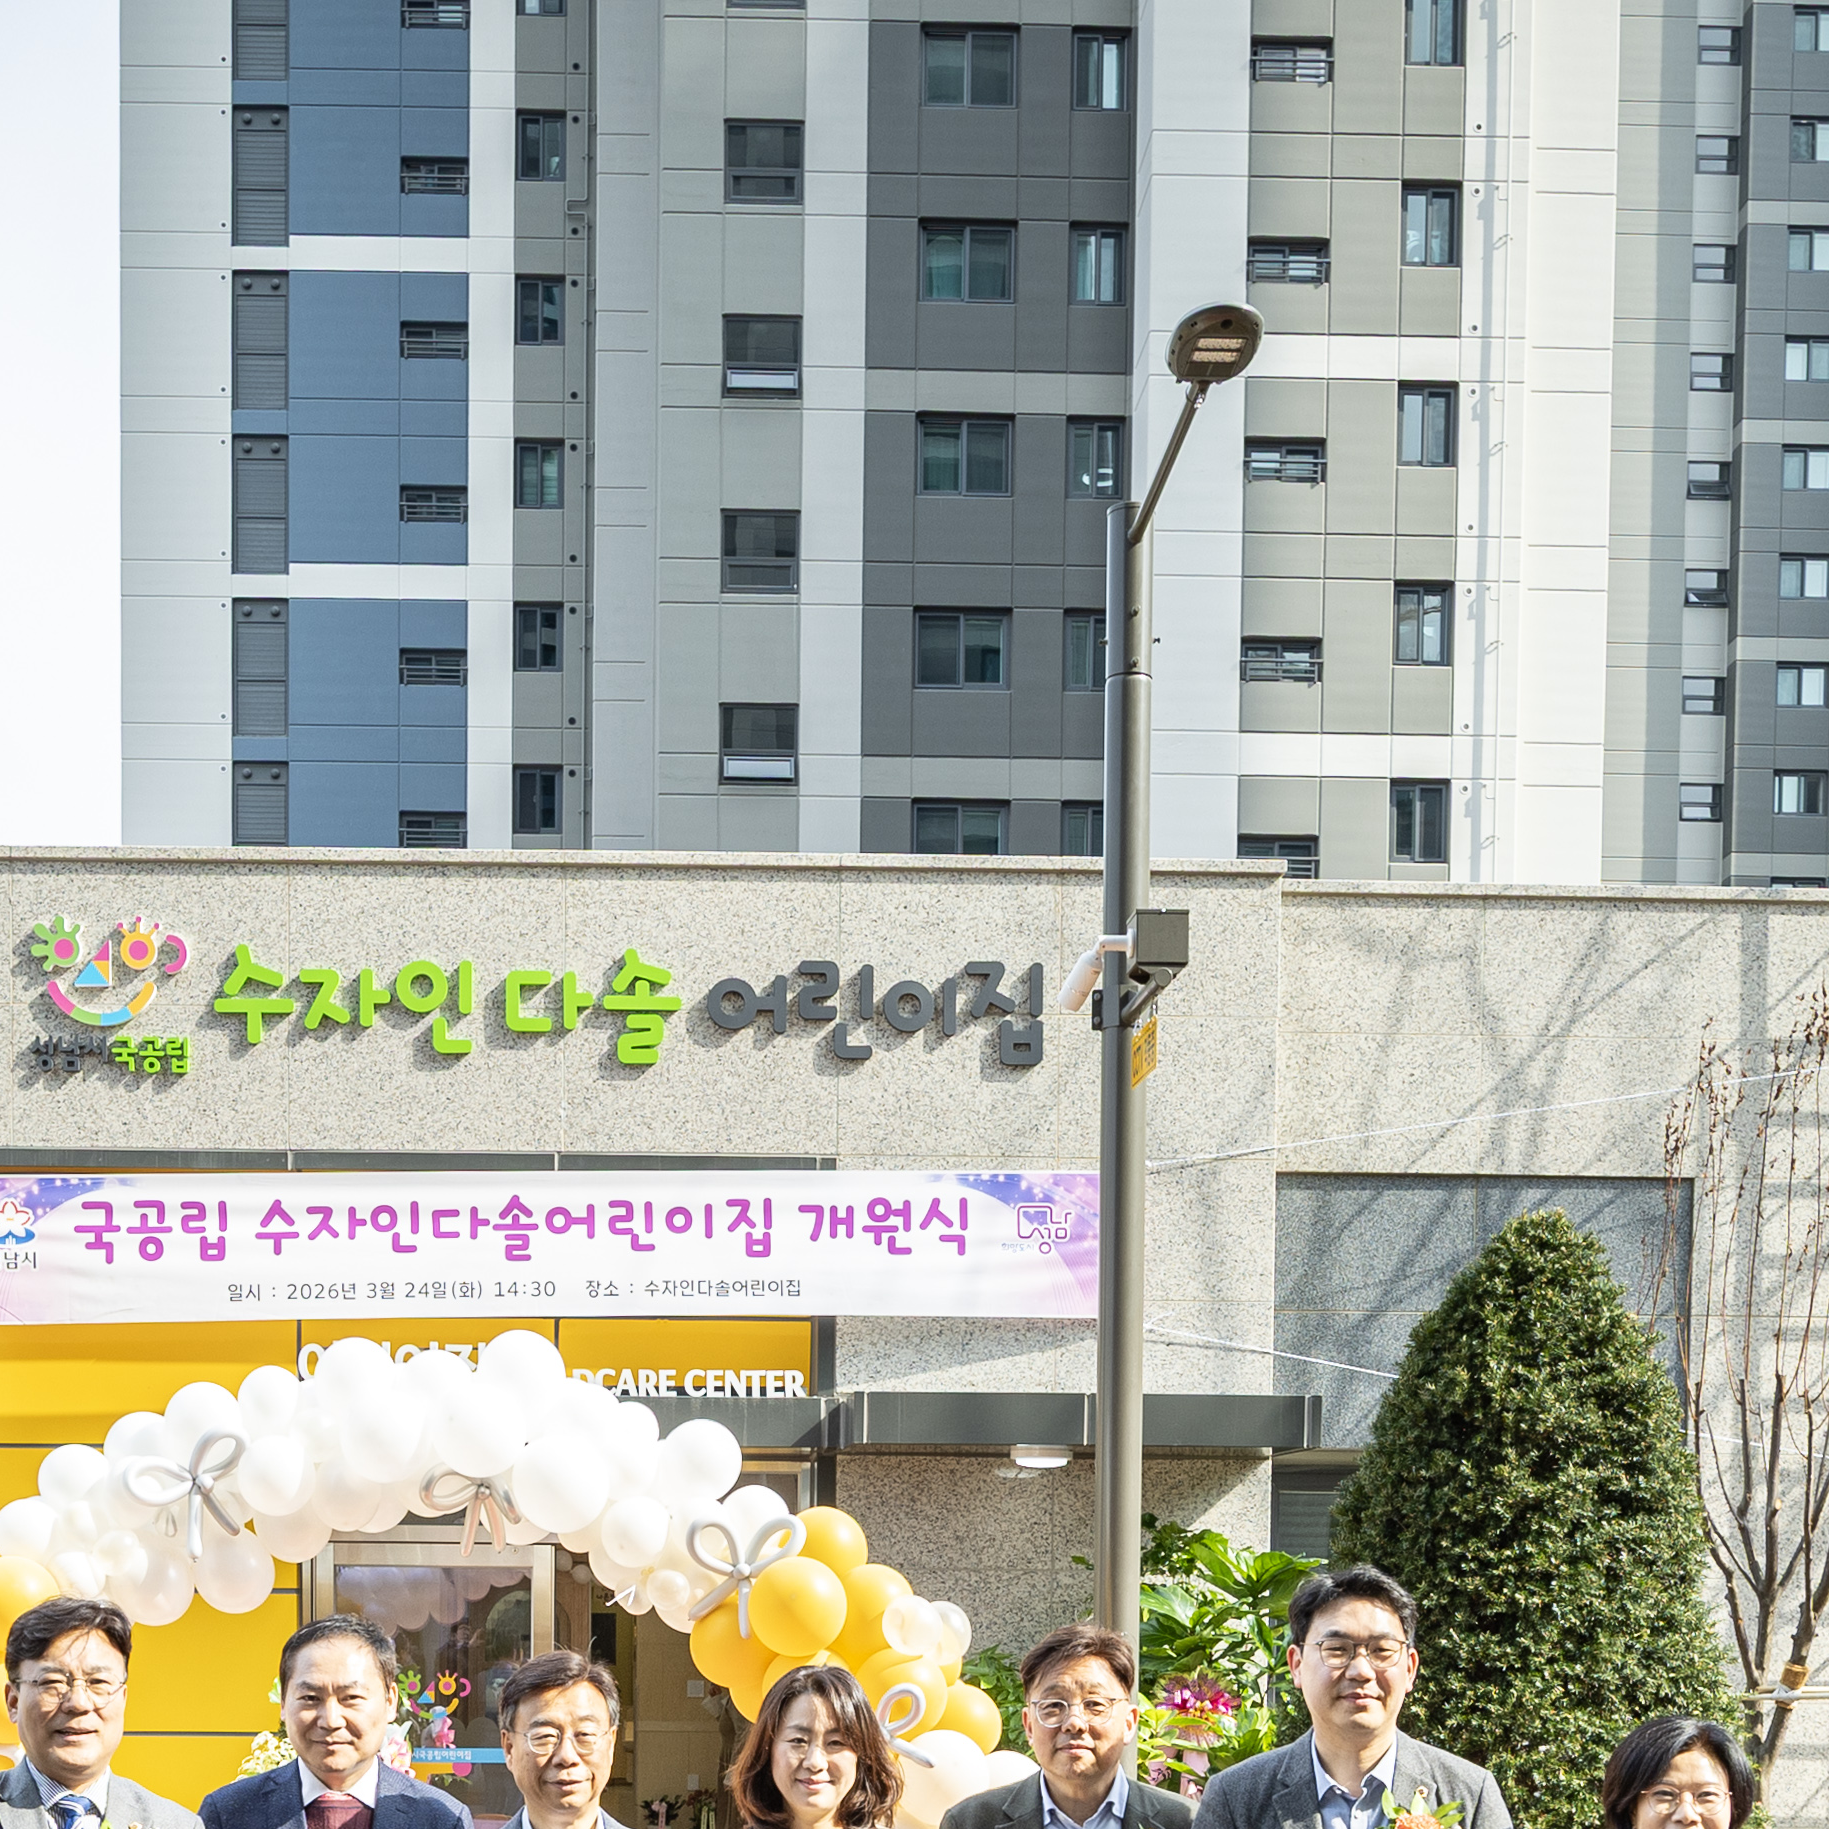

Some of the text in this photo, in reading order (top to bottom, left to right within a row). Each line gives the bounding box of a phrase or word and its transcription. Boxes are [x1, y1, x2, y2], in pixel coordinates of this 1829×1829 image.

[212, 943, 1044, 1067] 수자인 다솔 어린이집
[74, 1194, 970, 1264] 국공립 수자인다솔어린이집 개원식
[227, 1284, 261, 1302] 일시
[286, 1283, 357, 1300] 2026년
[366, 1282, 395, 1300] 3월
[404, 1281, 483, 1299] 24일(화)
[494, 1281, 556, 1298] 14:30
[585, 1280, 620, 1298] 장소
[644, 1279, 802, 1297] 수자인다솔어린이집
[684, 1369, 806, 1398] CENTER
